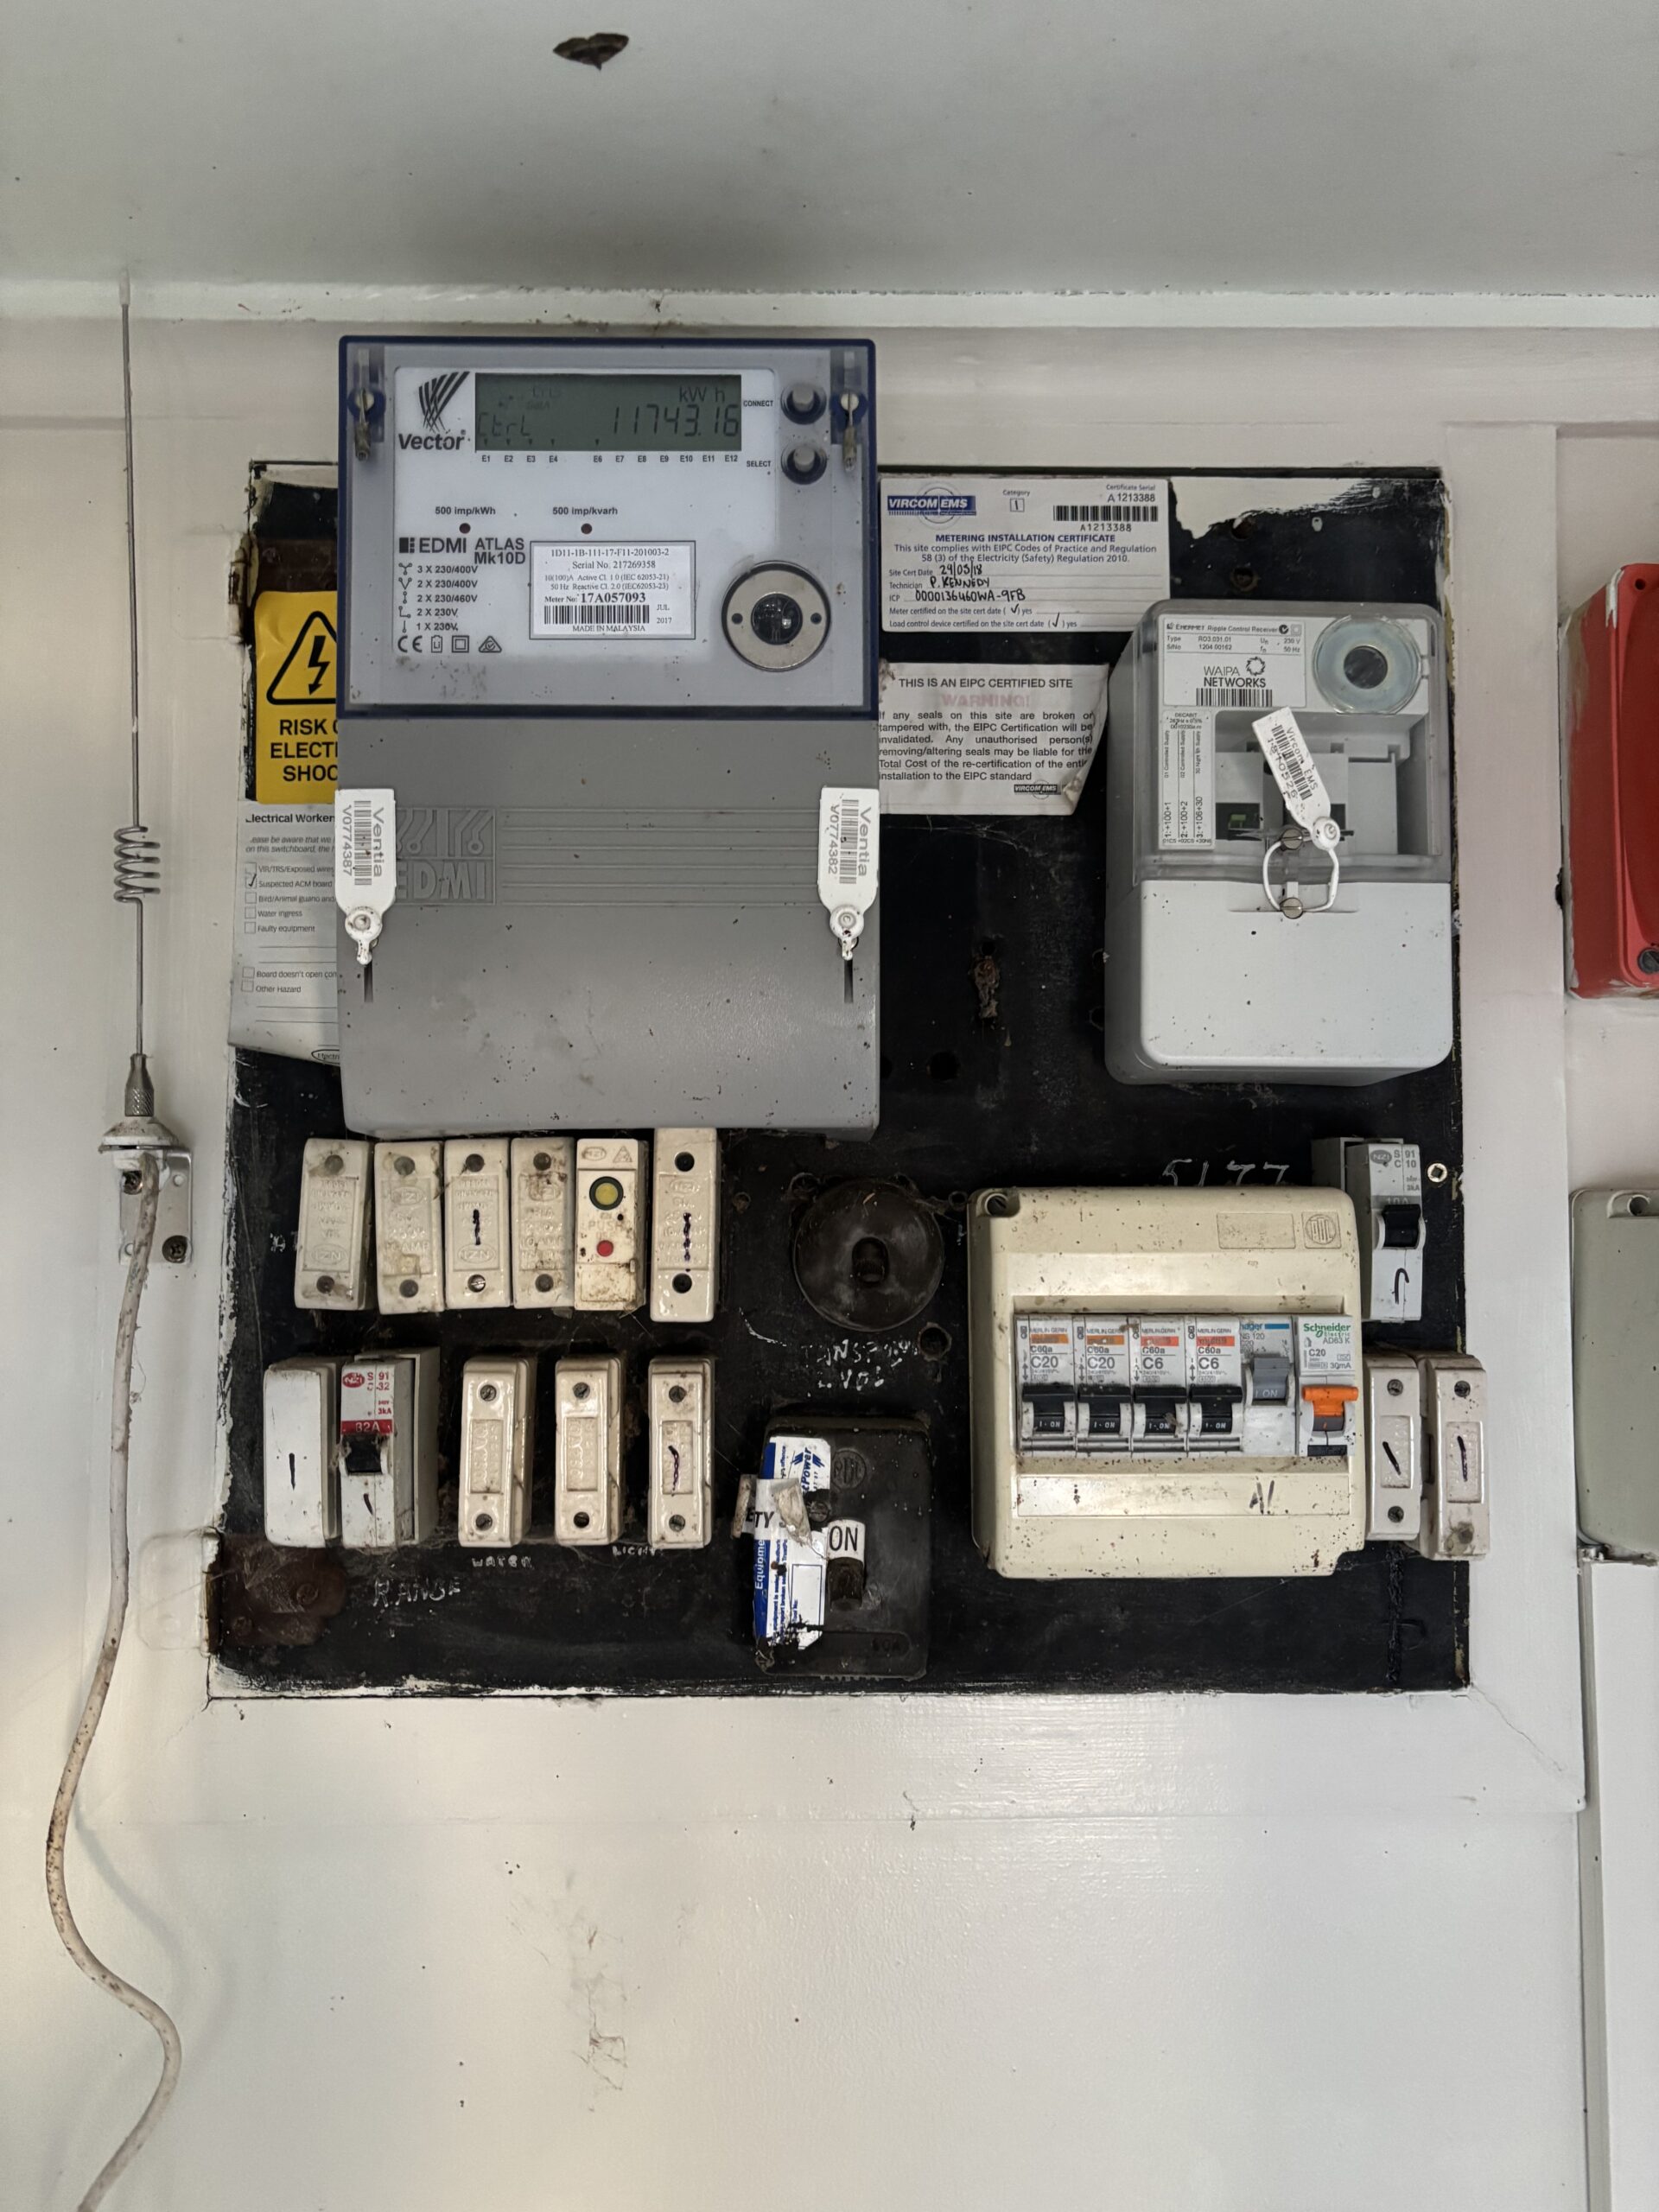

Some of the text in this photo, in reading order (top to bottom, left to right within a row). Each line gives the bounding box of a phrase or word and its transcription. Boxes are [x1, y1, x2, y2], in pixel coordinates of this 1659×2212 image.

[398, 434, 464, 449] Vector
[1118, 493, 1155, 502] 1213388
[889, 499, 968, 508] VIRCOM EMS
[435, 506, 496, 516] 500 imp/kWh
[552, 506, 618, 517] 500 imp/kvarh
[419, 538, 467, 553] EDMI
[475, 537, 524, 550] ATLAS
[894, 543, 1157, 553] This site complies with EIPC Codes of Practice and Regulation
[474, 552, 525, 564] Mk10D
[922, 554, 1104, 563] 58 (3) of the Electricity (Safety) Regulation
[417, 565, 478, 574] 3 X 230/400V
[572, 561, 656, 569] Serial 217269358
[942, 575, 989, 588] KENNEDY
[581, 593, 646, 603] 17A057093
[1204, 666, 1240, 676] WAIPA
[899, 678, 1072, 688] THIS IS AN EIPC CERTIFIED SITE
[1204, 677, 1266, 688] NETWORKS
[893, 711, 1075, 721] any seals this site are broken
[280, 719, 327, 734] RISK
[928, 723, 1077, 733] with, the EIPC Certification will
[945, 734, 1037, 745] Any unauthorised
[271, 742, 338, 759] ELECT
[965, 747, 1058, 757] seals may liable
[880, 760, 901, 768] Total
[1304, 769, 1319, 791] EMS
[342, 804, 353, 876] V0774387
[373, 807, 385, 877] Ventia
[828, 804, 840, 874] V0774382
[858, 807, 872, 876] Ventia
[1031, 1356, 1058, 1368] C20
[1088, 1357, 1116, 1369] C20
[1143, 1357, 1164, 1370] C6
[1198, 1357, 1219, 1370] C6
[378, 1372, 389, 1381] 91
[830, 1525, 857, 1552] ON
